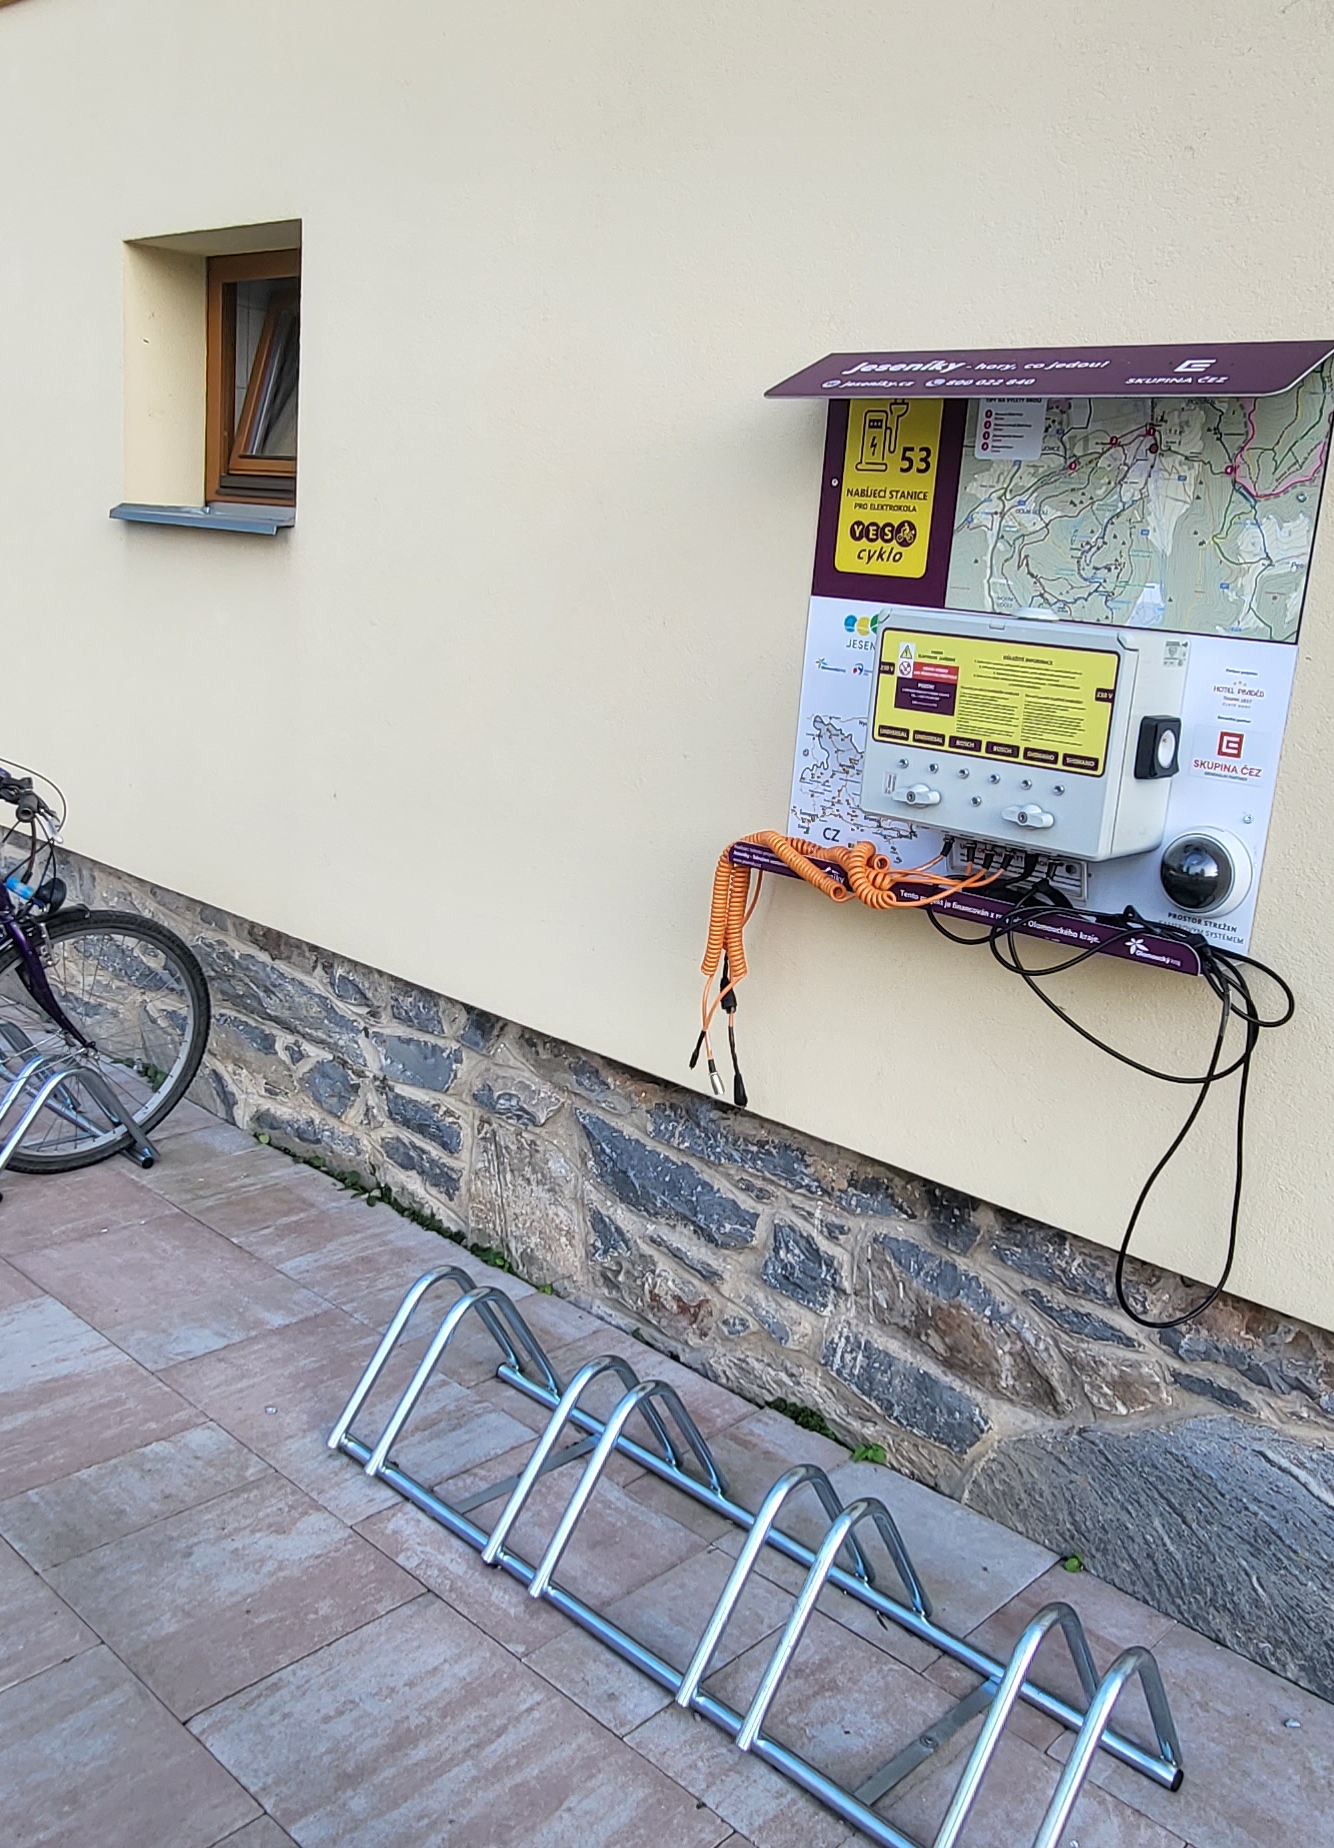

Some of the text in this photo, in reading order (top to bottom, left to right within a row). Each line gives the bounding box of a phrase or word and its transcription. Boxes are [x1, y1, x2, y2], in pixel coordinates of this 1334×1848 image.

[841, 360, 966, 376] Jeseníky
[974, 362, 1017, 372] hory,
[1045, 360, 1111, 371] jedou!
[975, 378, 1003, 386] 022
[1125, 374, 1229, 385] SKUPINA ČEZ
[899, 446, 932, 474] 53
[846, 486, 929, 501] NABÍJECÍ STANICE
[854, 502, 917, 513] PRO ELEKTROKOLA
[851, 522, 893, 541] YES
[857, 546, 903, 565] cyklo
[1213, 685, 1235, 694] HOTEL
[955, 739, 975, 748] BOSCH
[1193, 759, 1263, 778] SKUPINA ČEZ
[822, 827, 841, 842] CZ
[900, 888, 919, 901] Tento
[1028, 919, 1078, 939] Olomouckého
[1079, 926, 1101, 944] kraje.
[1167, 911, 1203, 926] PROSTOR
[1204, 929, 1245, 945] SYSTÉMEM
[1135, 950, 1171, 965] Olomoucký
